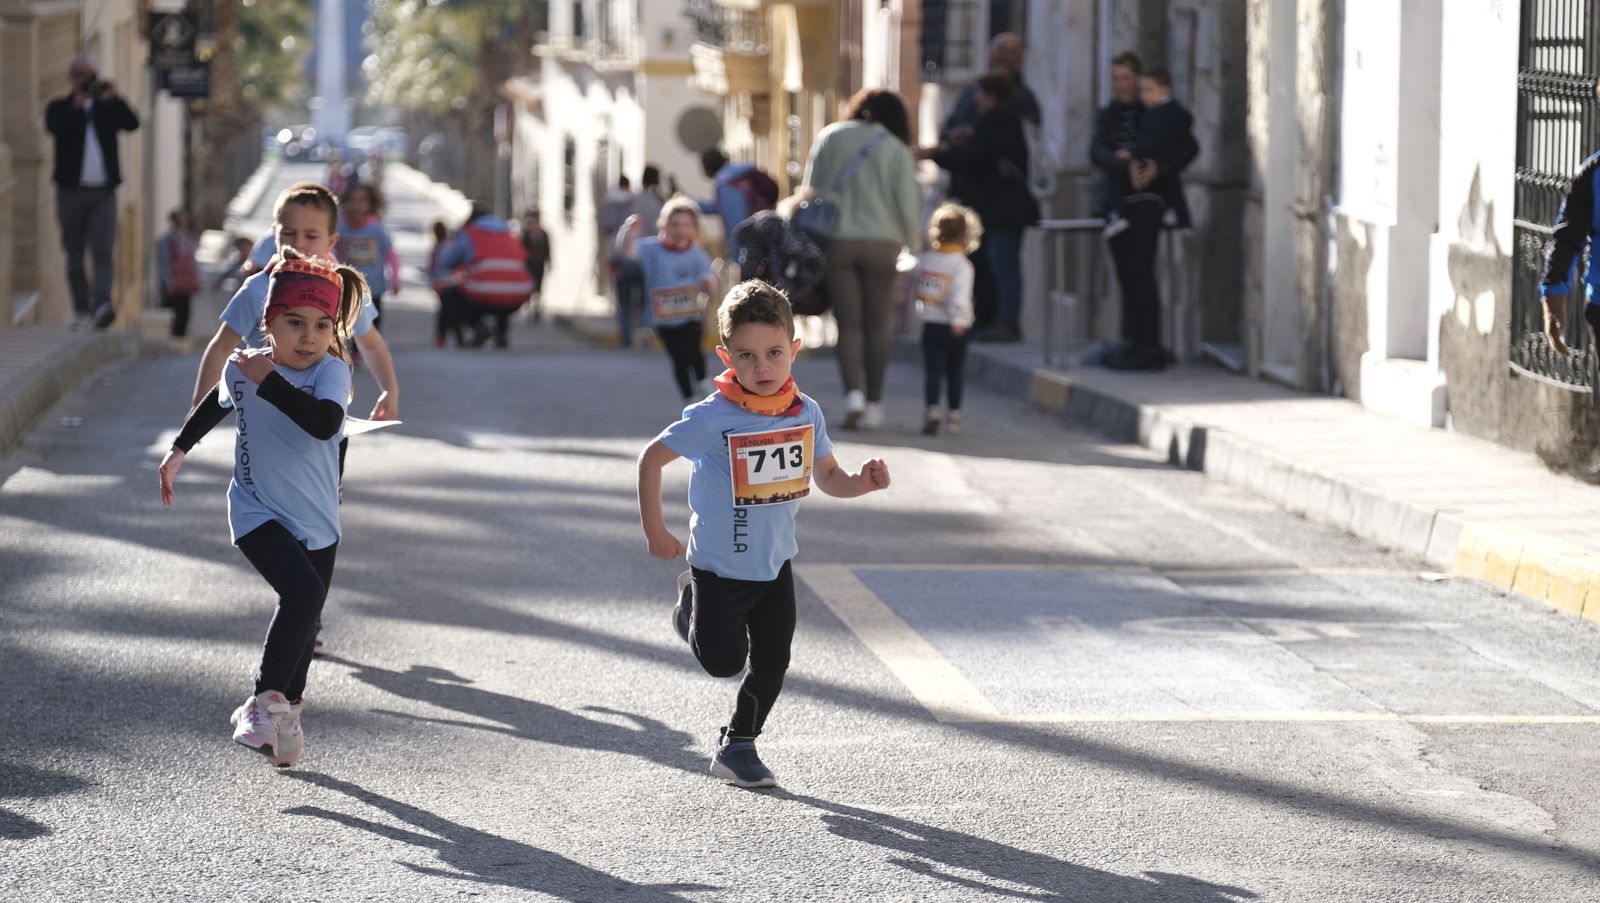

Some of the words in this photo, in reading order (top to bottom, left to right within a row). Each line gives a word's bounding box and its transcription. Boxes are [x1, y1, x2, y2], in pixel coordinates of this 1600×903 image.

[233, 381, 246, 402] LA
[748, 444, 803, 473] 713
[733, 508, 748, 553] RILLA
